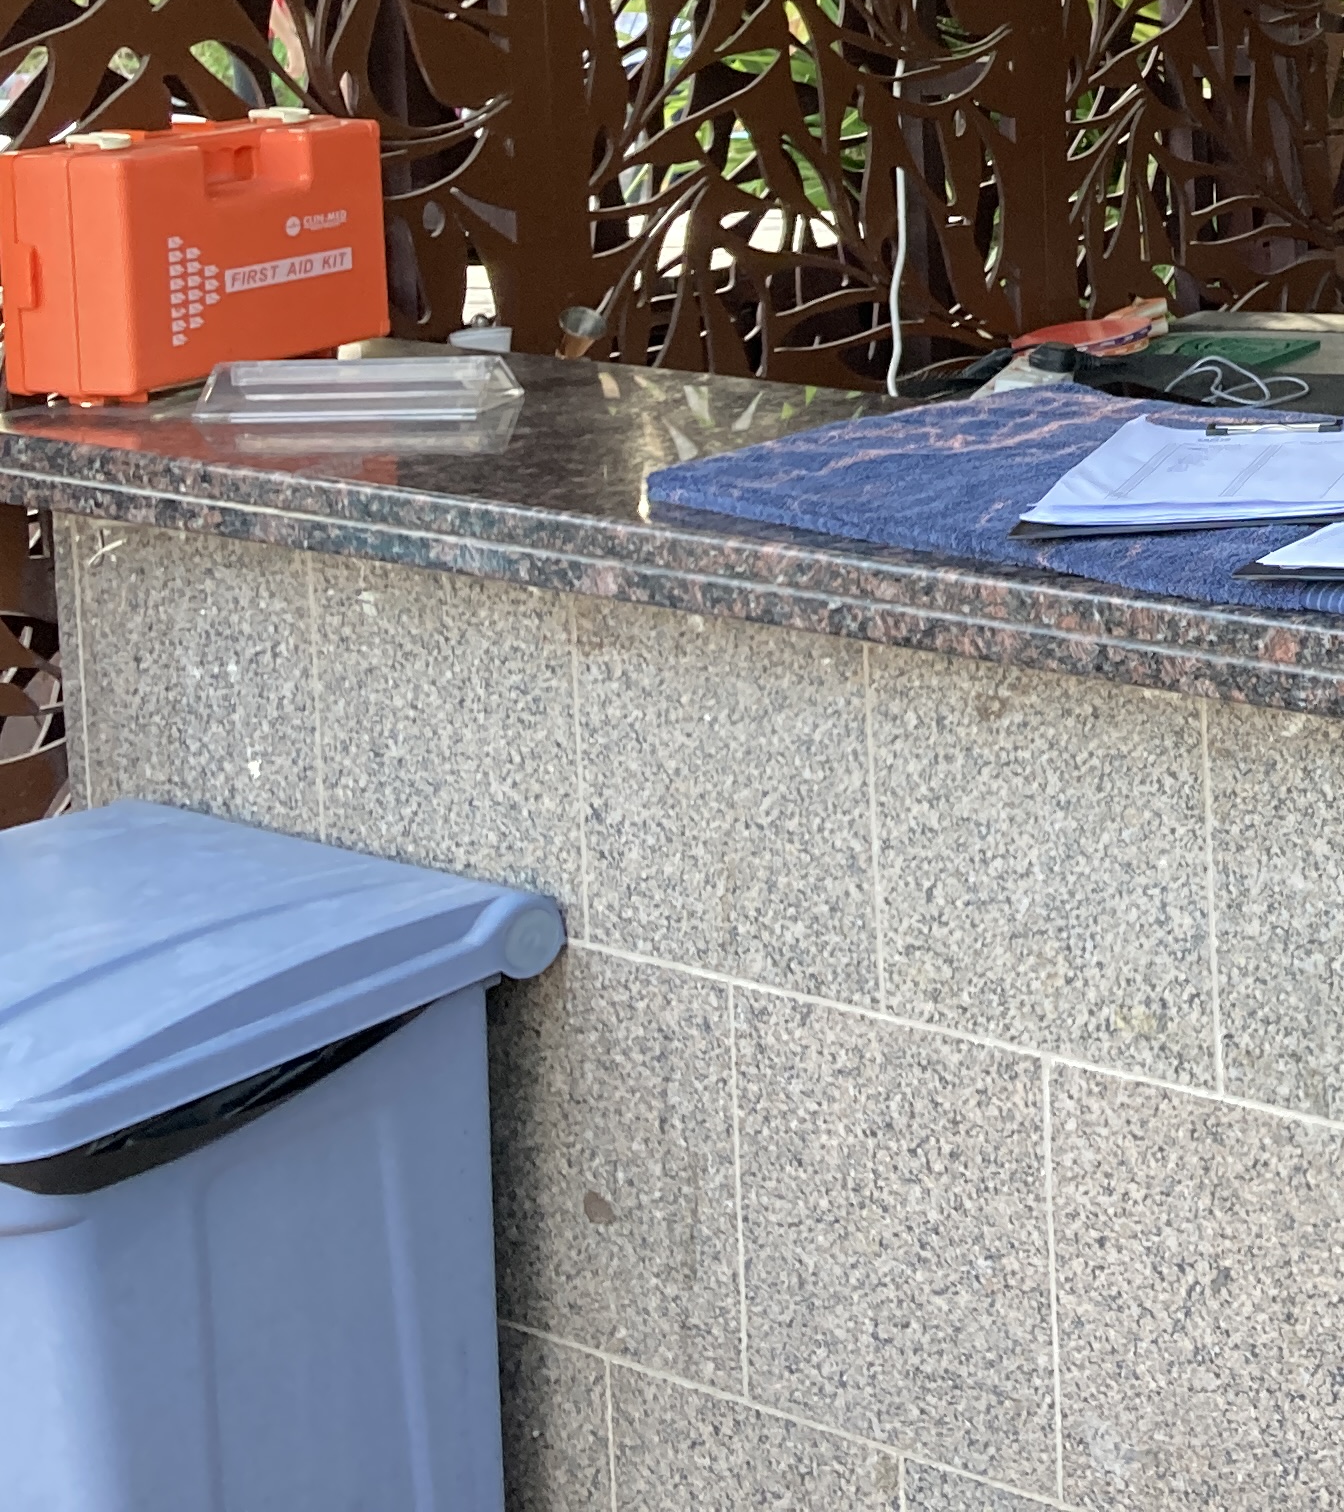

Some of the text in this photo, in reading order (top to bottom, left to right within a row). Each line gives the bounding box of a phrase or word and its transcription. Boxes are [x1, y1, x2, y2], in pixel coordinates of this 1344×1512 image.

[230, 252, 348, 289] FIRST AID KIT
